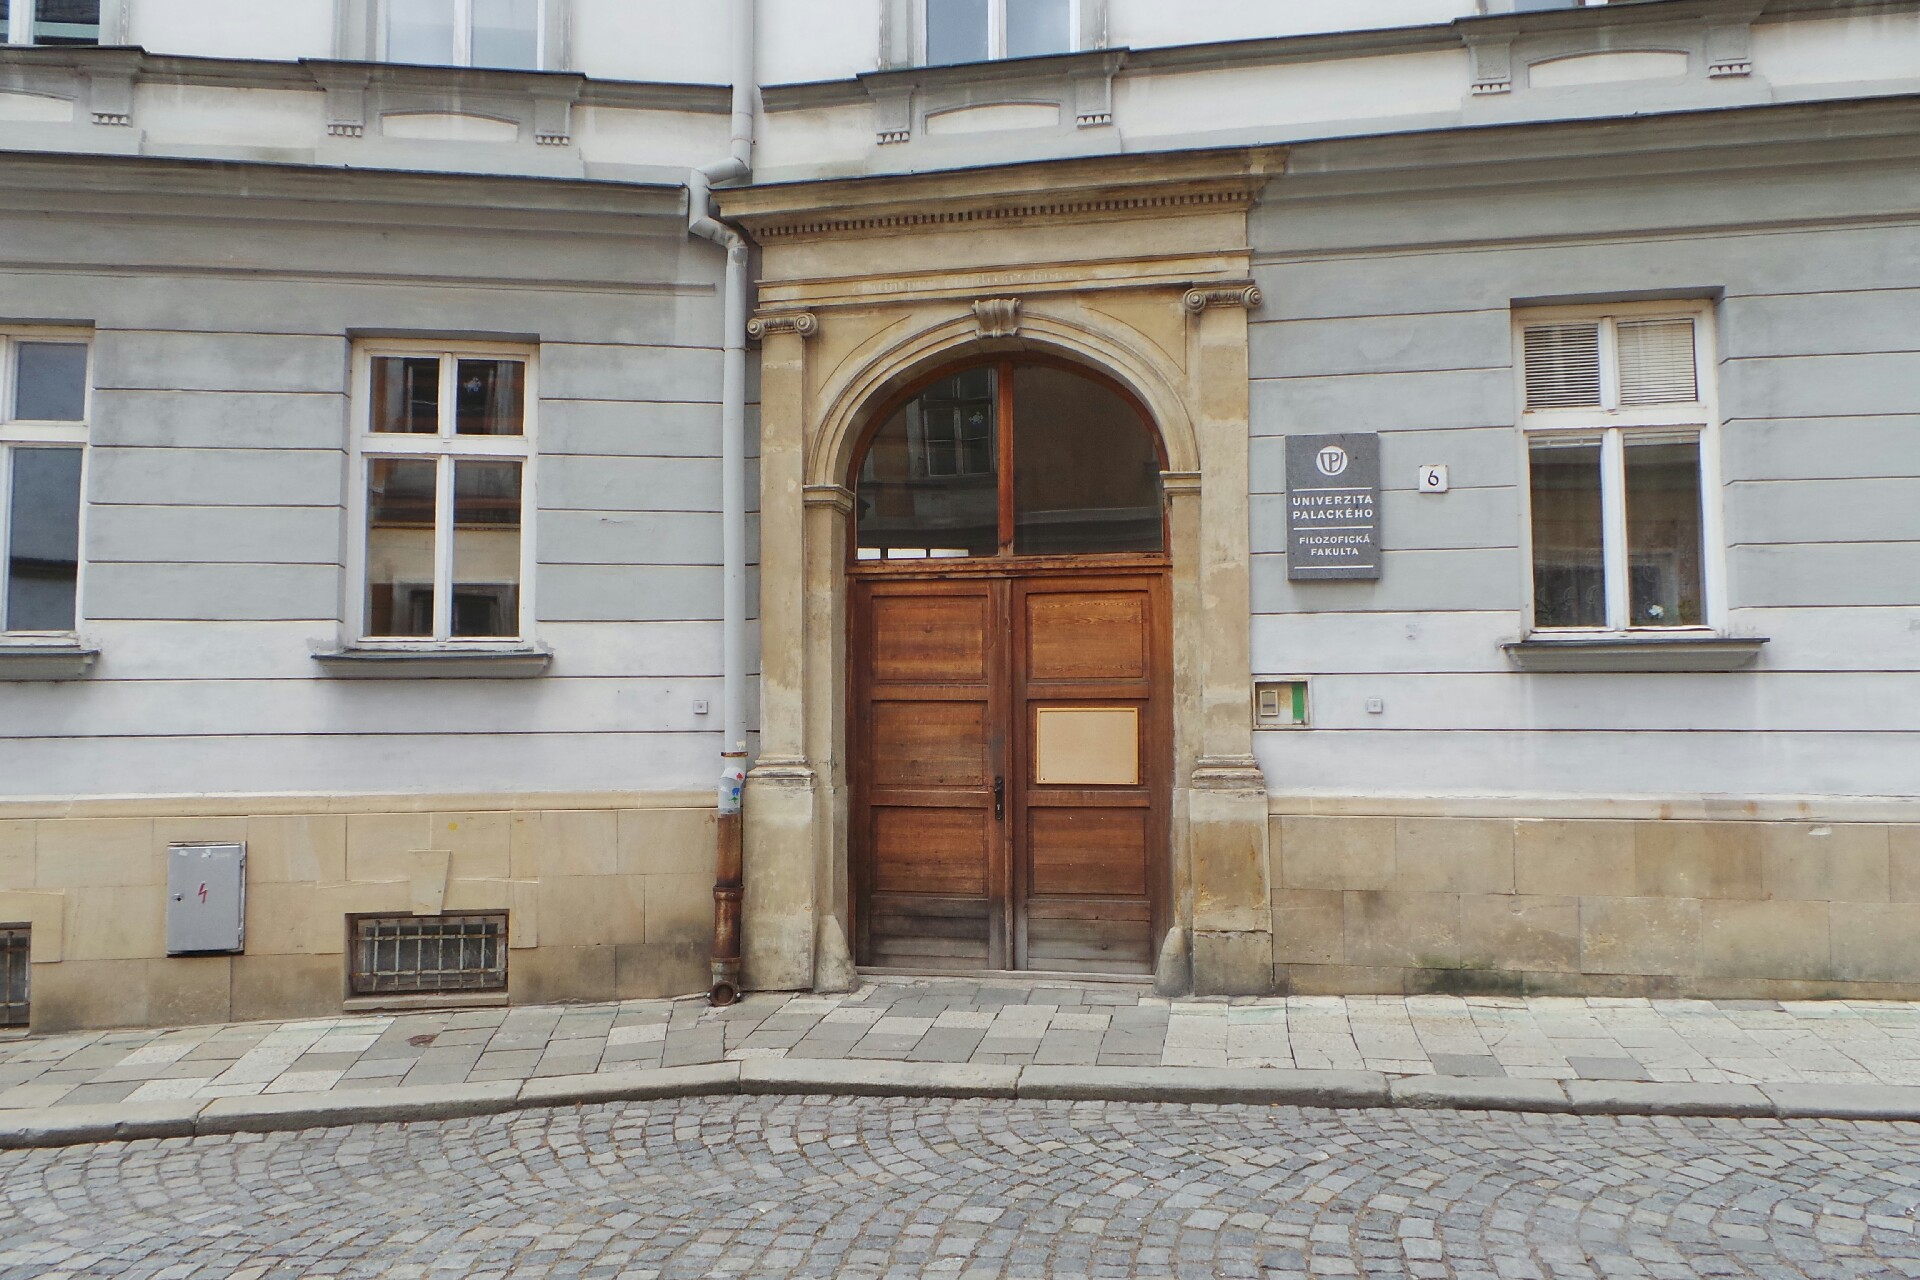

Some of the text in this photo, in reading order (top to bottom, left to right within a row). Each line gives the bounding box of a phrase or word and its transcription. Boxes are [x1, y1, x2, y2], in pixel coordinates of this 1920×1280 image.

[1427, 469, 1439, 487] 6
[1292, 495, 1373, 506] UNIVERZITA
[1292, 507, 1374, 520] PALACKÉHO
[1299, 533, 1371, 545] FILOZOFICKÁ
[1310, 547, 1359, 556] FAKULTA
